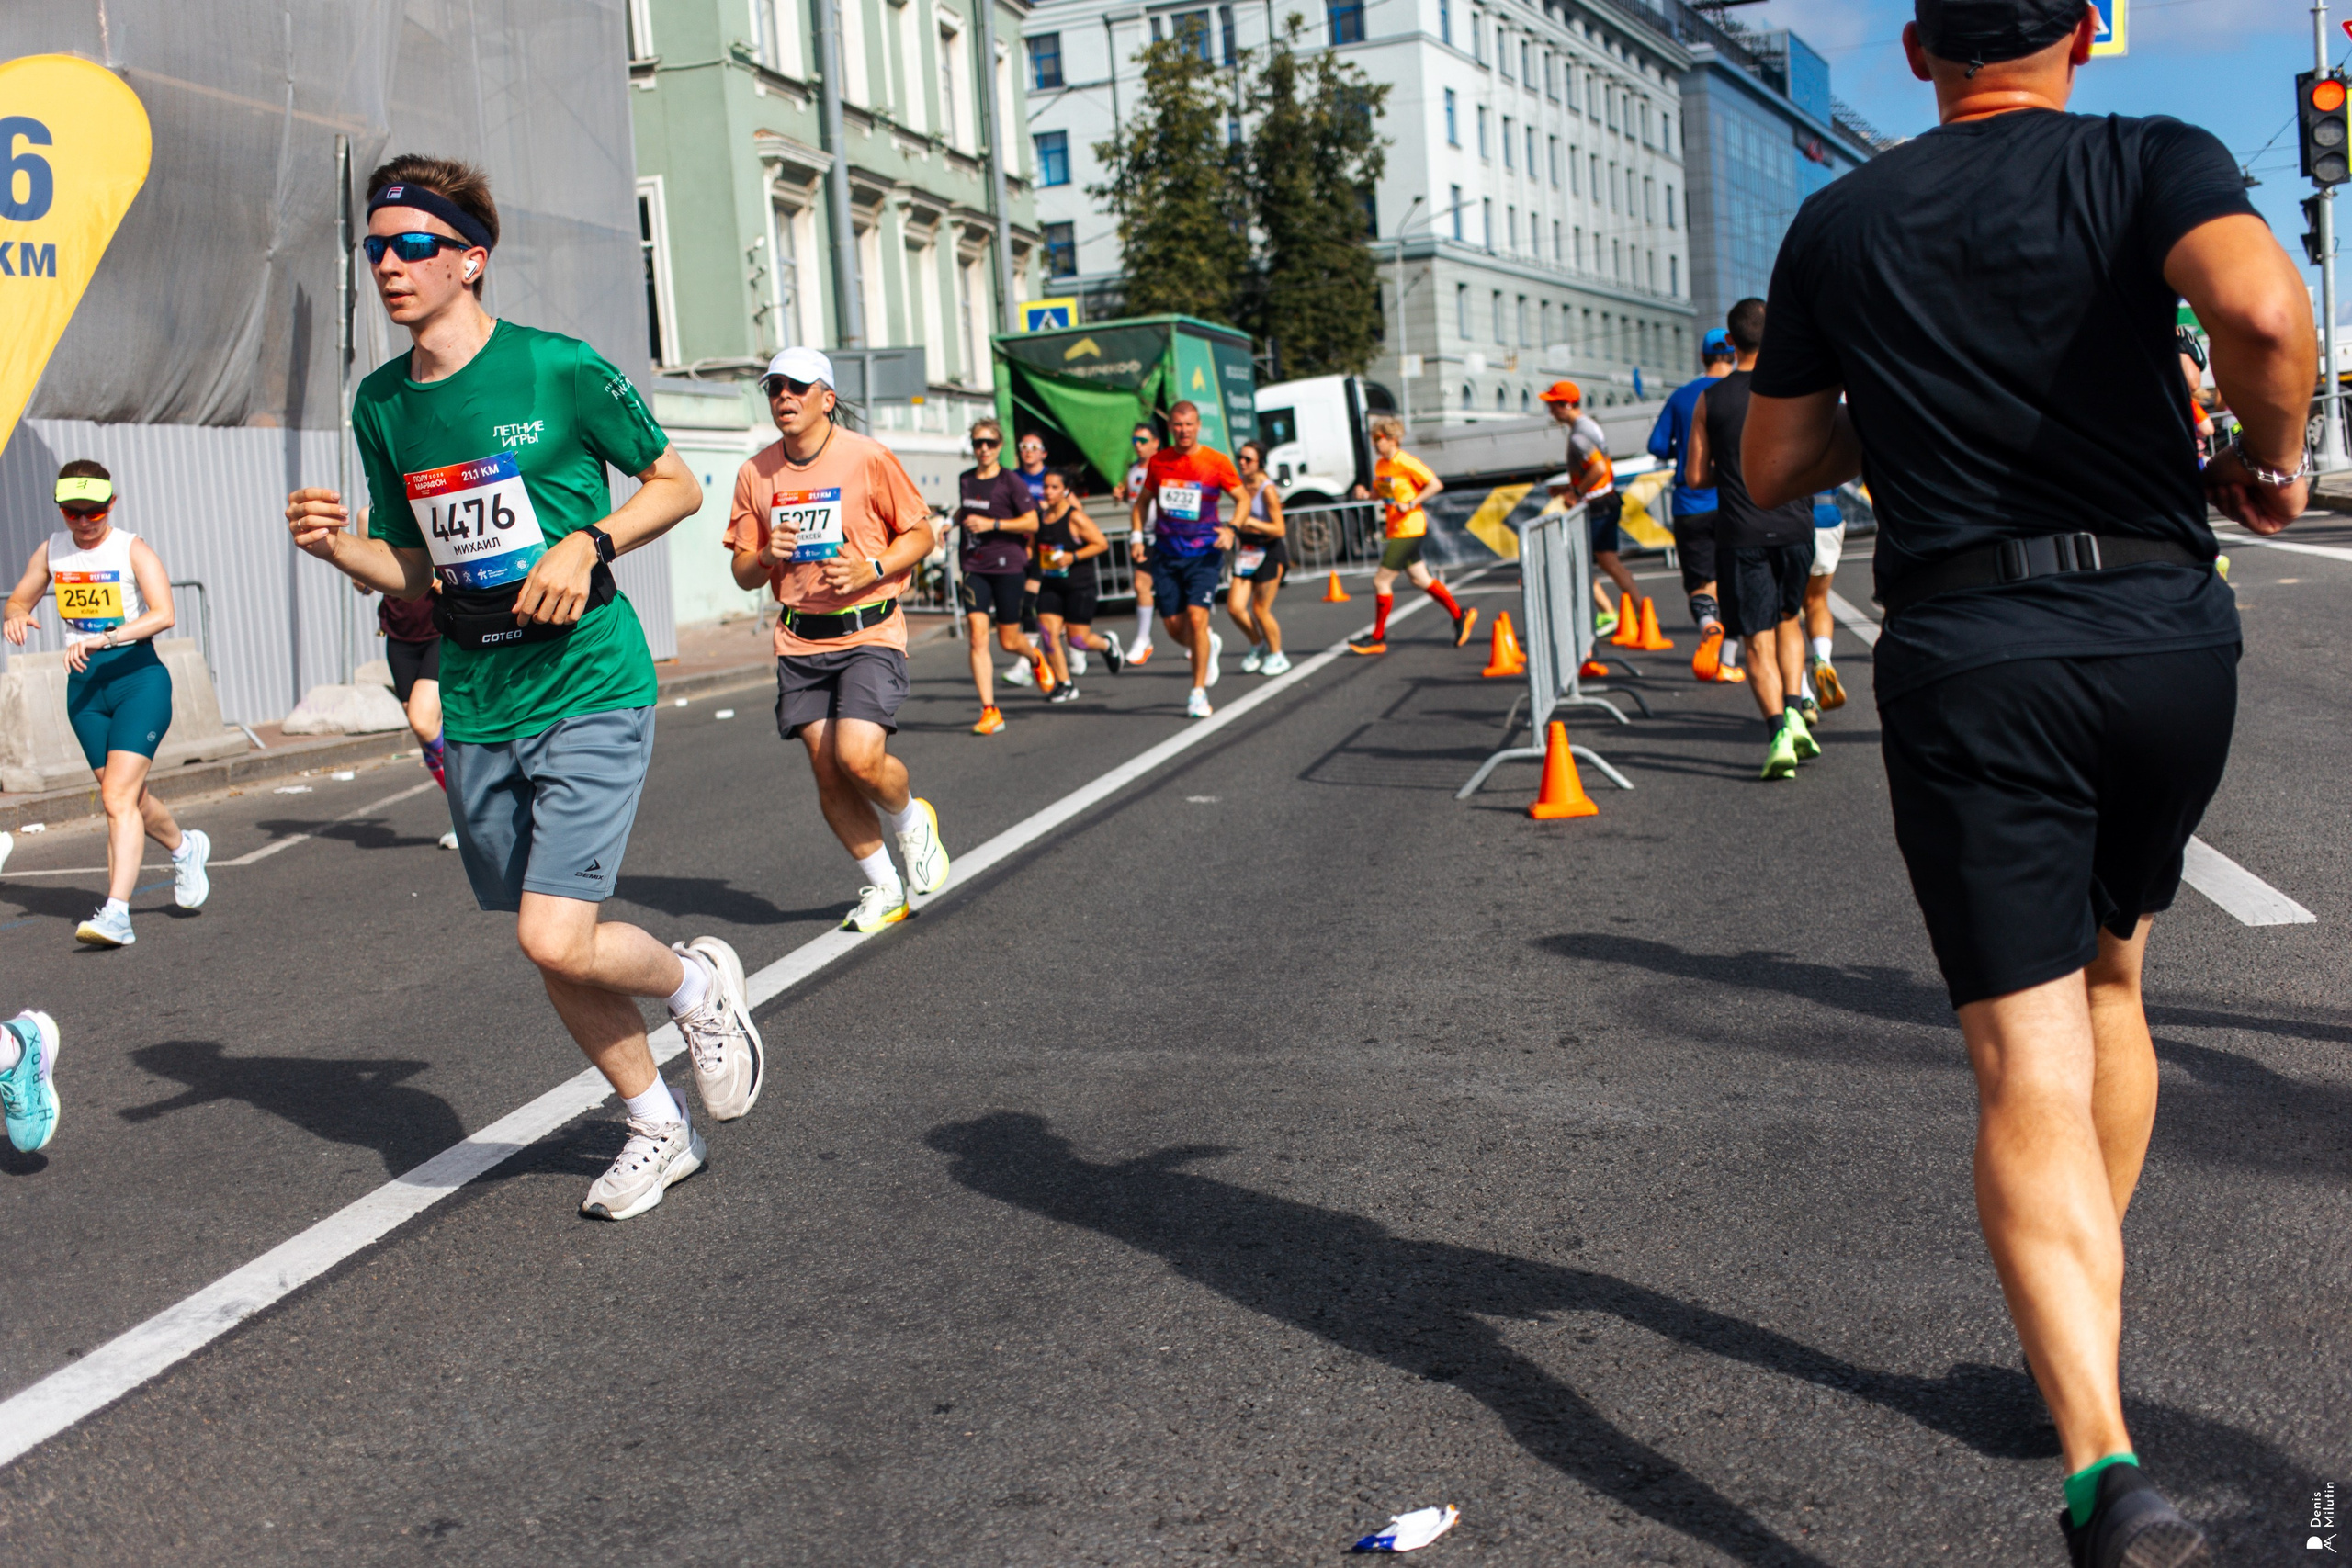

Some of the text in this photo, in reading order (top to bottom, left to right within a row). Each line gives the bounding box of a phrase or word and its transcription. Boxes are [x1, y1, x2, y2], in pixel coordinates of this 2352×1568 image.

[492, 420, 545, 438] ЛЕТНИЕ
[501, 432, 539, 448] ИГРЫ
[413, 474, 428, 483] ПОЛУ
[461, 463, 500, 481] 21,1 КМ
[414, 478, 447, 491] МАРАФОН
[431, 492, 516, 542] 4476
[453, 536, 501, 556] МИХАИЛ
[63, 589, 110, 607] 2541
[574, 871, 605, 881] DEMIX
